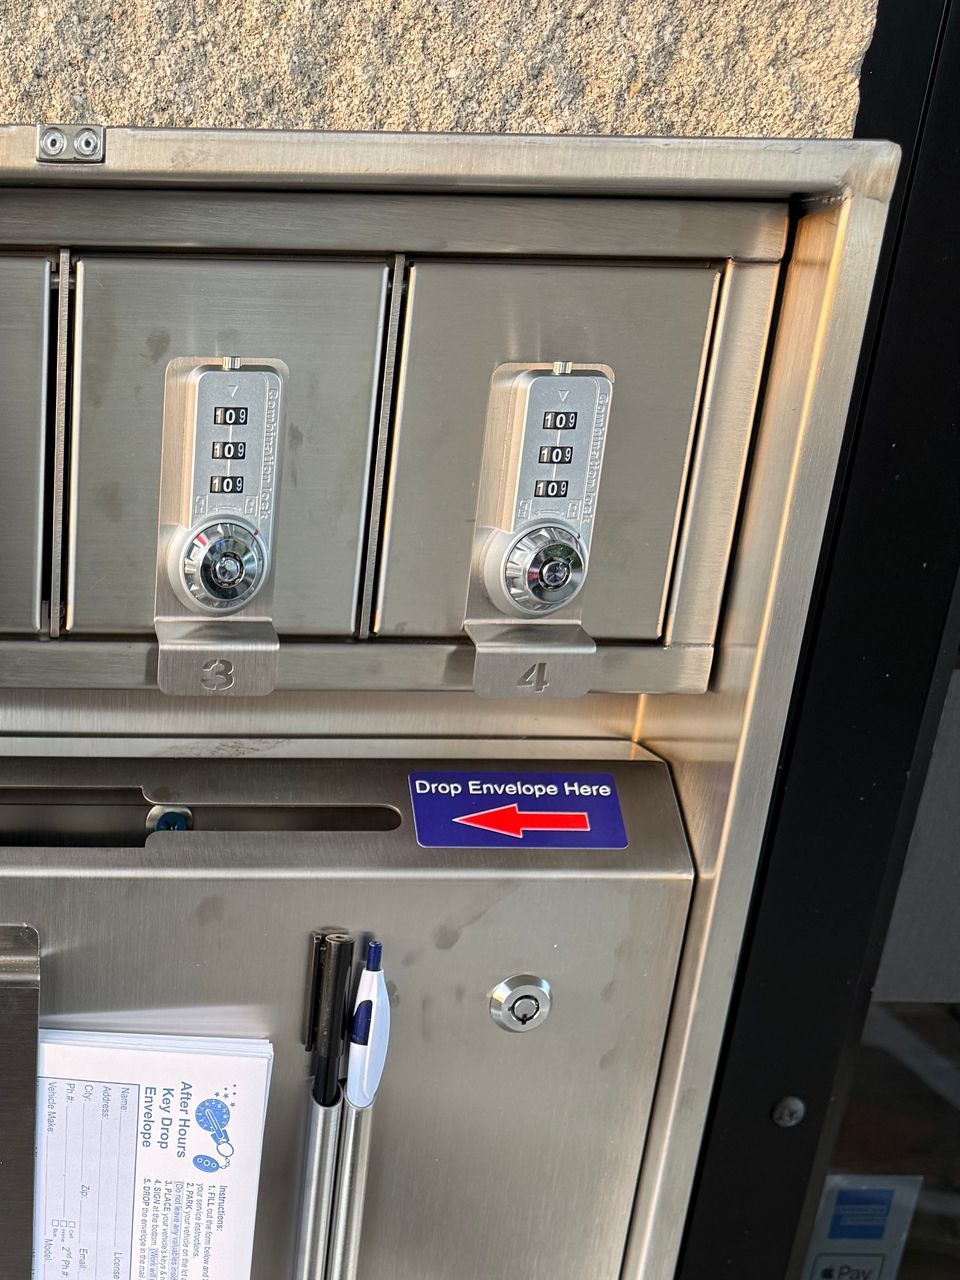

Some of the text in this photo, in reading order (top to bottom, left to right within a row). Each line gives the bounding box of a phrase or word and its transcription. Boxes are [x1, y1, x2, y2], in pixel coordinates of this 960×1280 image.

[200, 658, 235, 690] 3
[516, 662, 550, 691] 4
[415, 780, 612, 798] Drop Envelope Here
[82, 1084, 94, 1101] City:
[102, 1086, 112, 1119] Address:
[120, 1087, 130, 1112] Name:
[47, 1082, 57, 1134] Vehicle Make:
[140, 1087, 156, 1148] Envelope
[157, 1088, 174, 1149] Key Drop
[177, 1081, 192, 1158] After Hours
[80, 1185, 90, 1199] Zip:
[153, 1187, 161, 1204] SIGN
[164, 1188, 172, 1212] PLACE
[185, 1190, 193, 1209] PARK
[207, 1192, 215, 1207] FILL
[217, 1185, 228, 1231] Instructions:
[44, 1239, 53, 1262] Model:
[62, 1247, 72, 1258] 2nd
[79, 1249, 88, 1270] Email:
[113, 1252, 123, 1279] License
